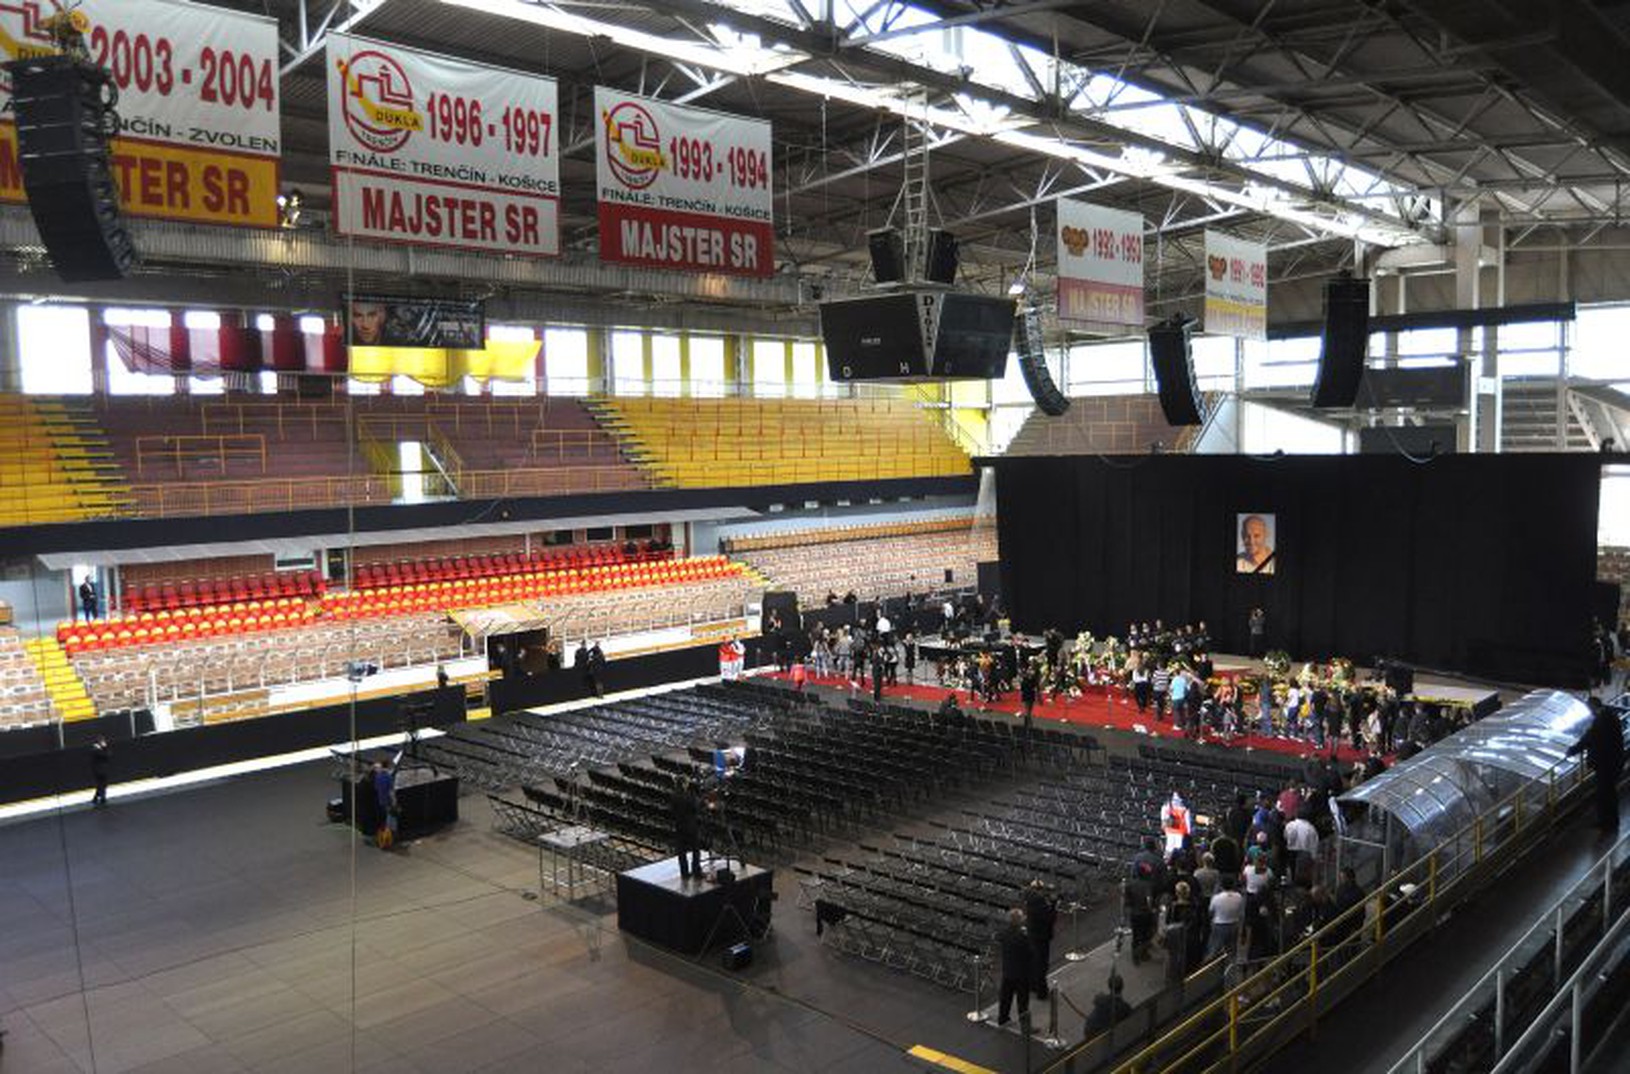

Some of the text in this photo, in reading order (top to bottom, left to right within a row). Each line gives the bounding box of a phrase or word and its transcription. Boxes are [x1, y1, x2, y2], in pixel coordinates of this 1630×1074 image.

[91, 25, 174, 96] 2003
[200, 47, 274, 111] 2004
[189, 128, 278, 152] ZVOLEN
[376, 109, 418, 127] DUKLA
[427, 91, 482, 147] 1996
[502, 106, 551, 157] 1997
[411, 160, 486, 183] TRENČÍN
[498, 174, 557, 193] KOŠICE
[670, 136, 713, 182] 1993
[727, 146, 768, 190] 1994
[202, 165, 249, 215] SR
[362, 187, 539, 245] MAJSTER SR
[621, 219, 758, 270] MAJSTER SR
